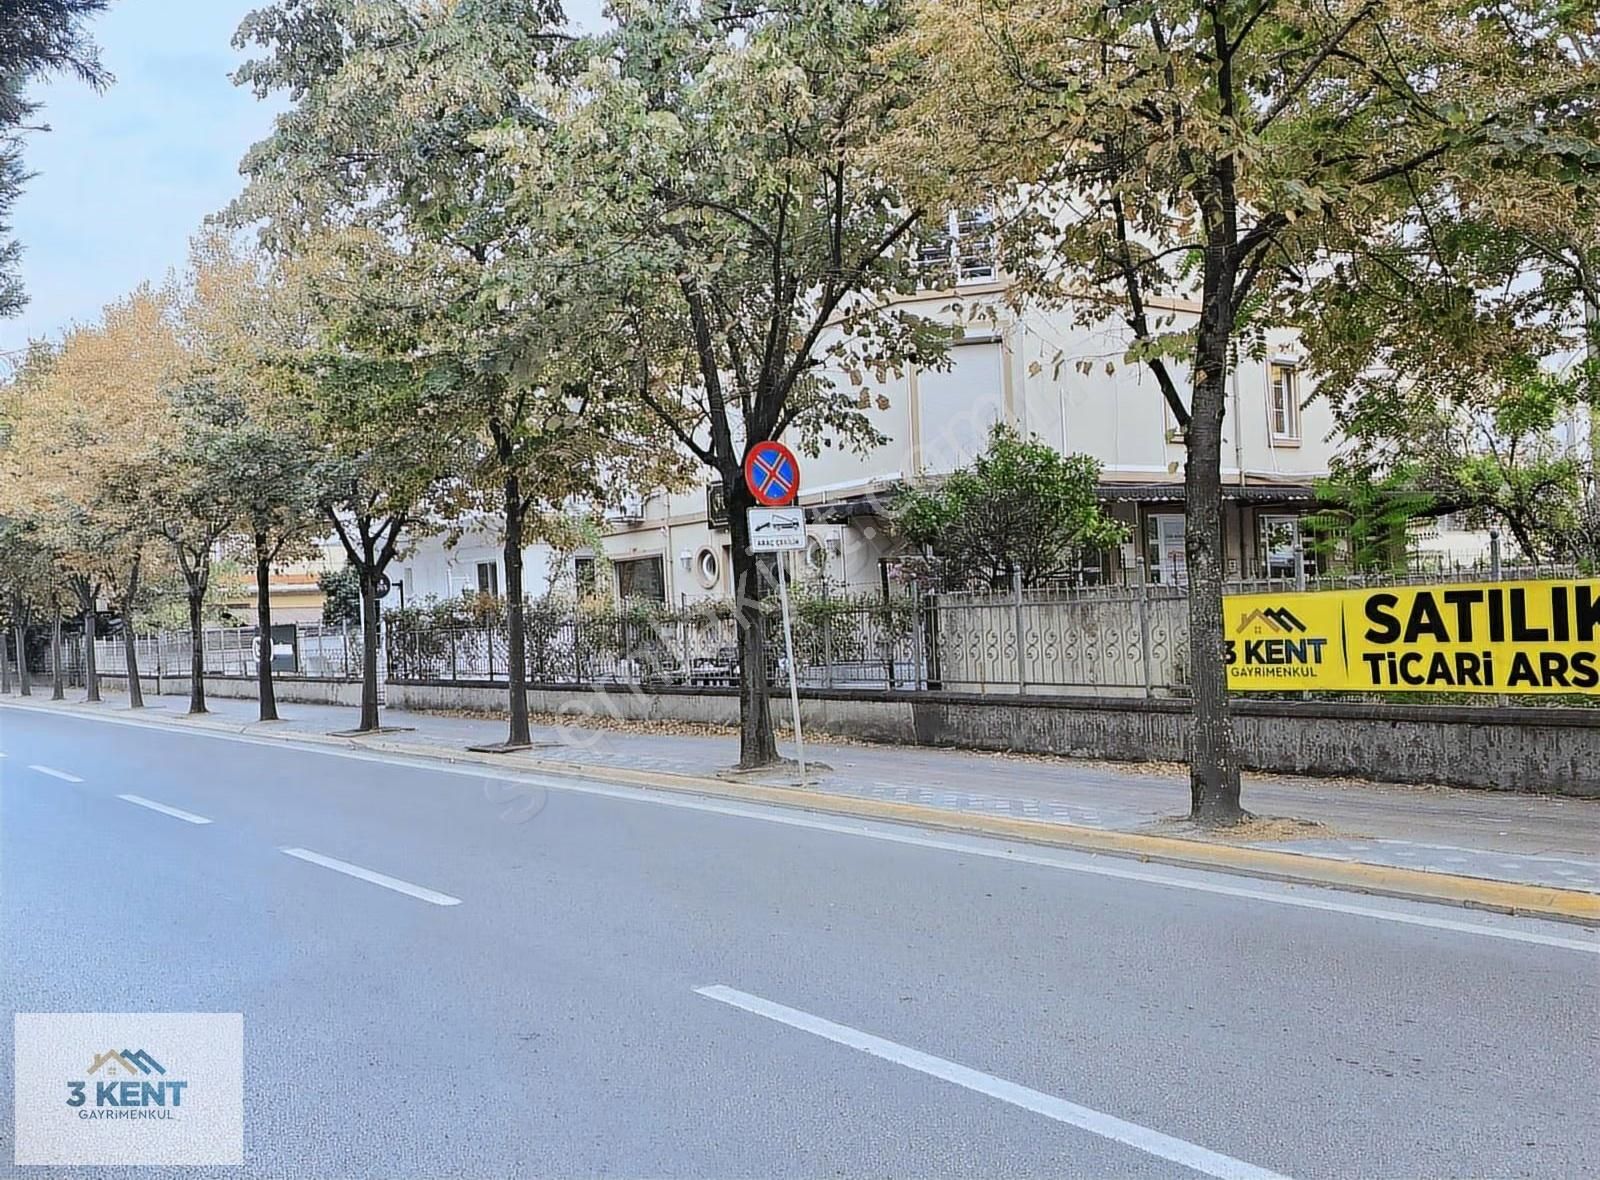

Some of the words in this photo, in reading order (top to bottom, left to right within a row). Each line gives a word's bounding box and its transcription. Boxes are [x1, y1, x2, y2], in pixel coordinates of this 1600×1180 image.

[1364, 585, 1600, 645] SATILIK
[1245, 639, 1327, 665] KENT
[1507, 651, 1600, 688] ARS
